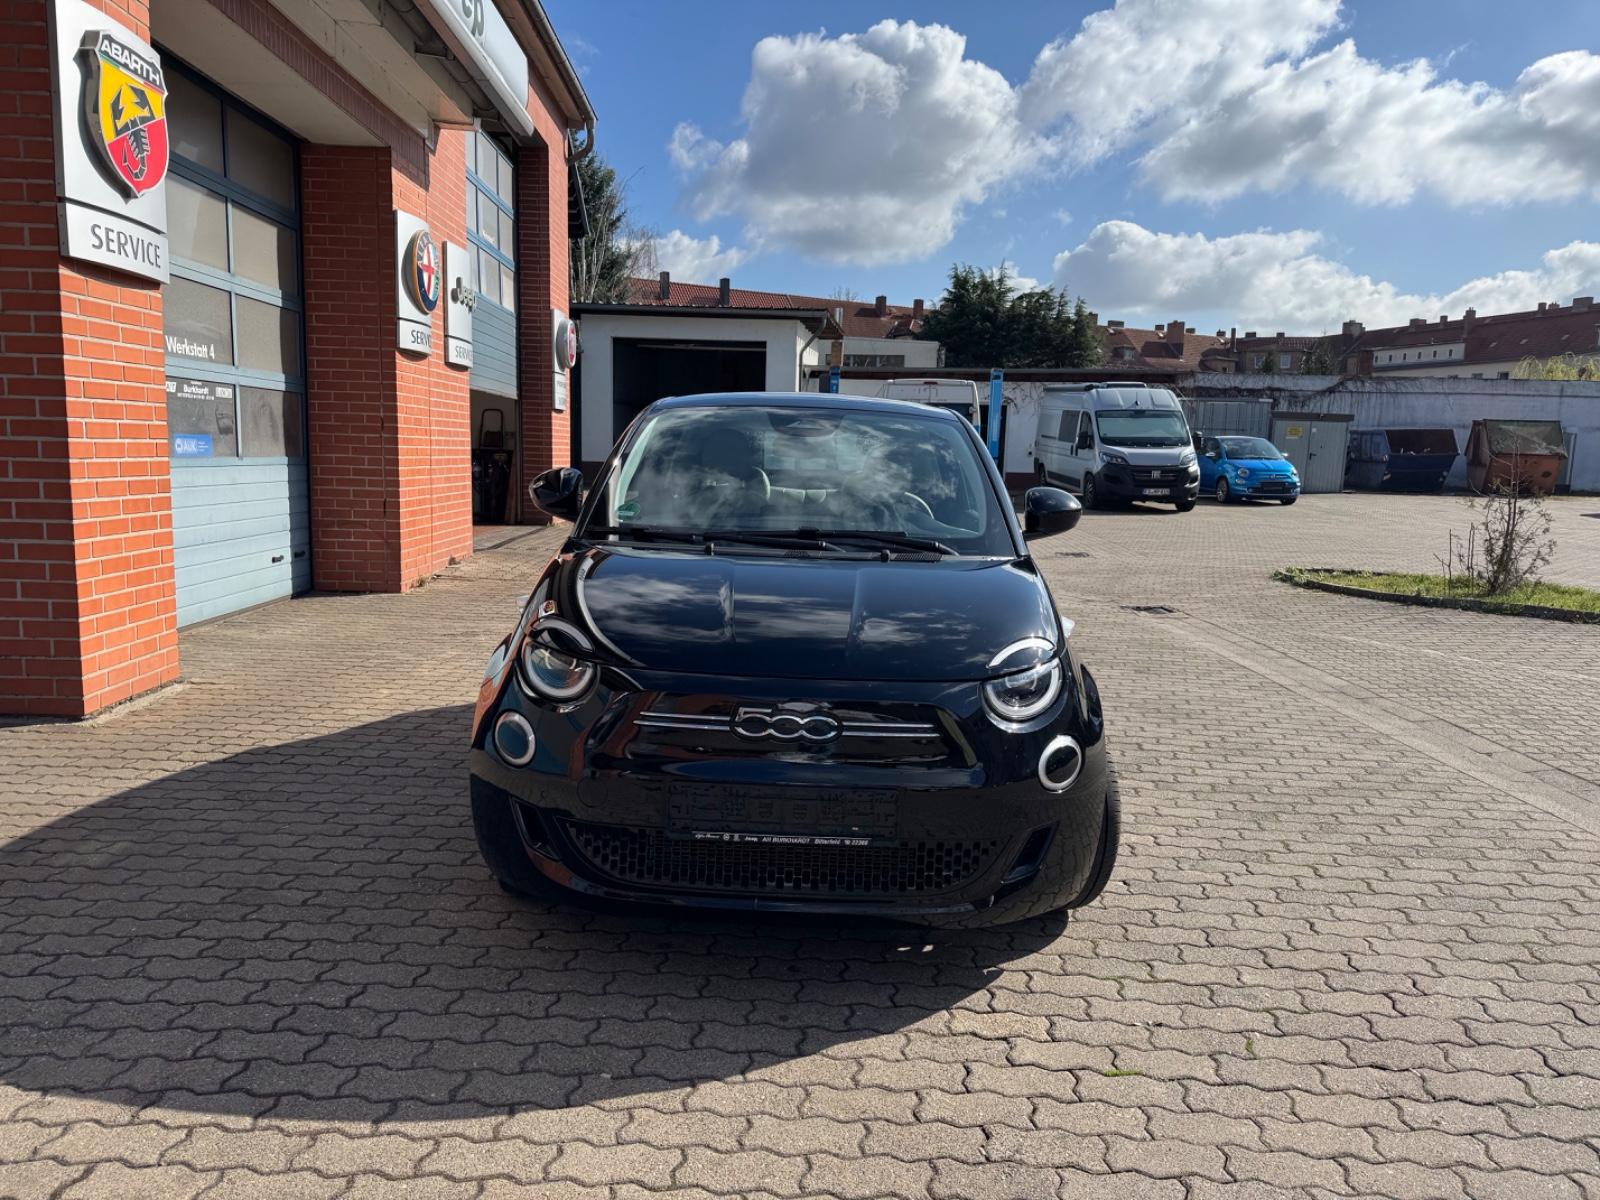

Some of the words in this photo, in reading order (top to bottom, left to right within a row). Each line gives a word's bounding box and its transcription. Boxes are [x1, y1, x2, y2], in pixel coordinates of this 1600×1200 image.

[100, 38, 161, 85] ABARTH
[90, 223, 162, 269] SERVICE
[165, 335, 209, 359] Werkstatt
[209, 344, 215, 360] 4
[735, 706, 837, 739] 500
